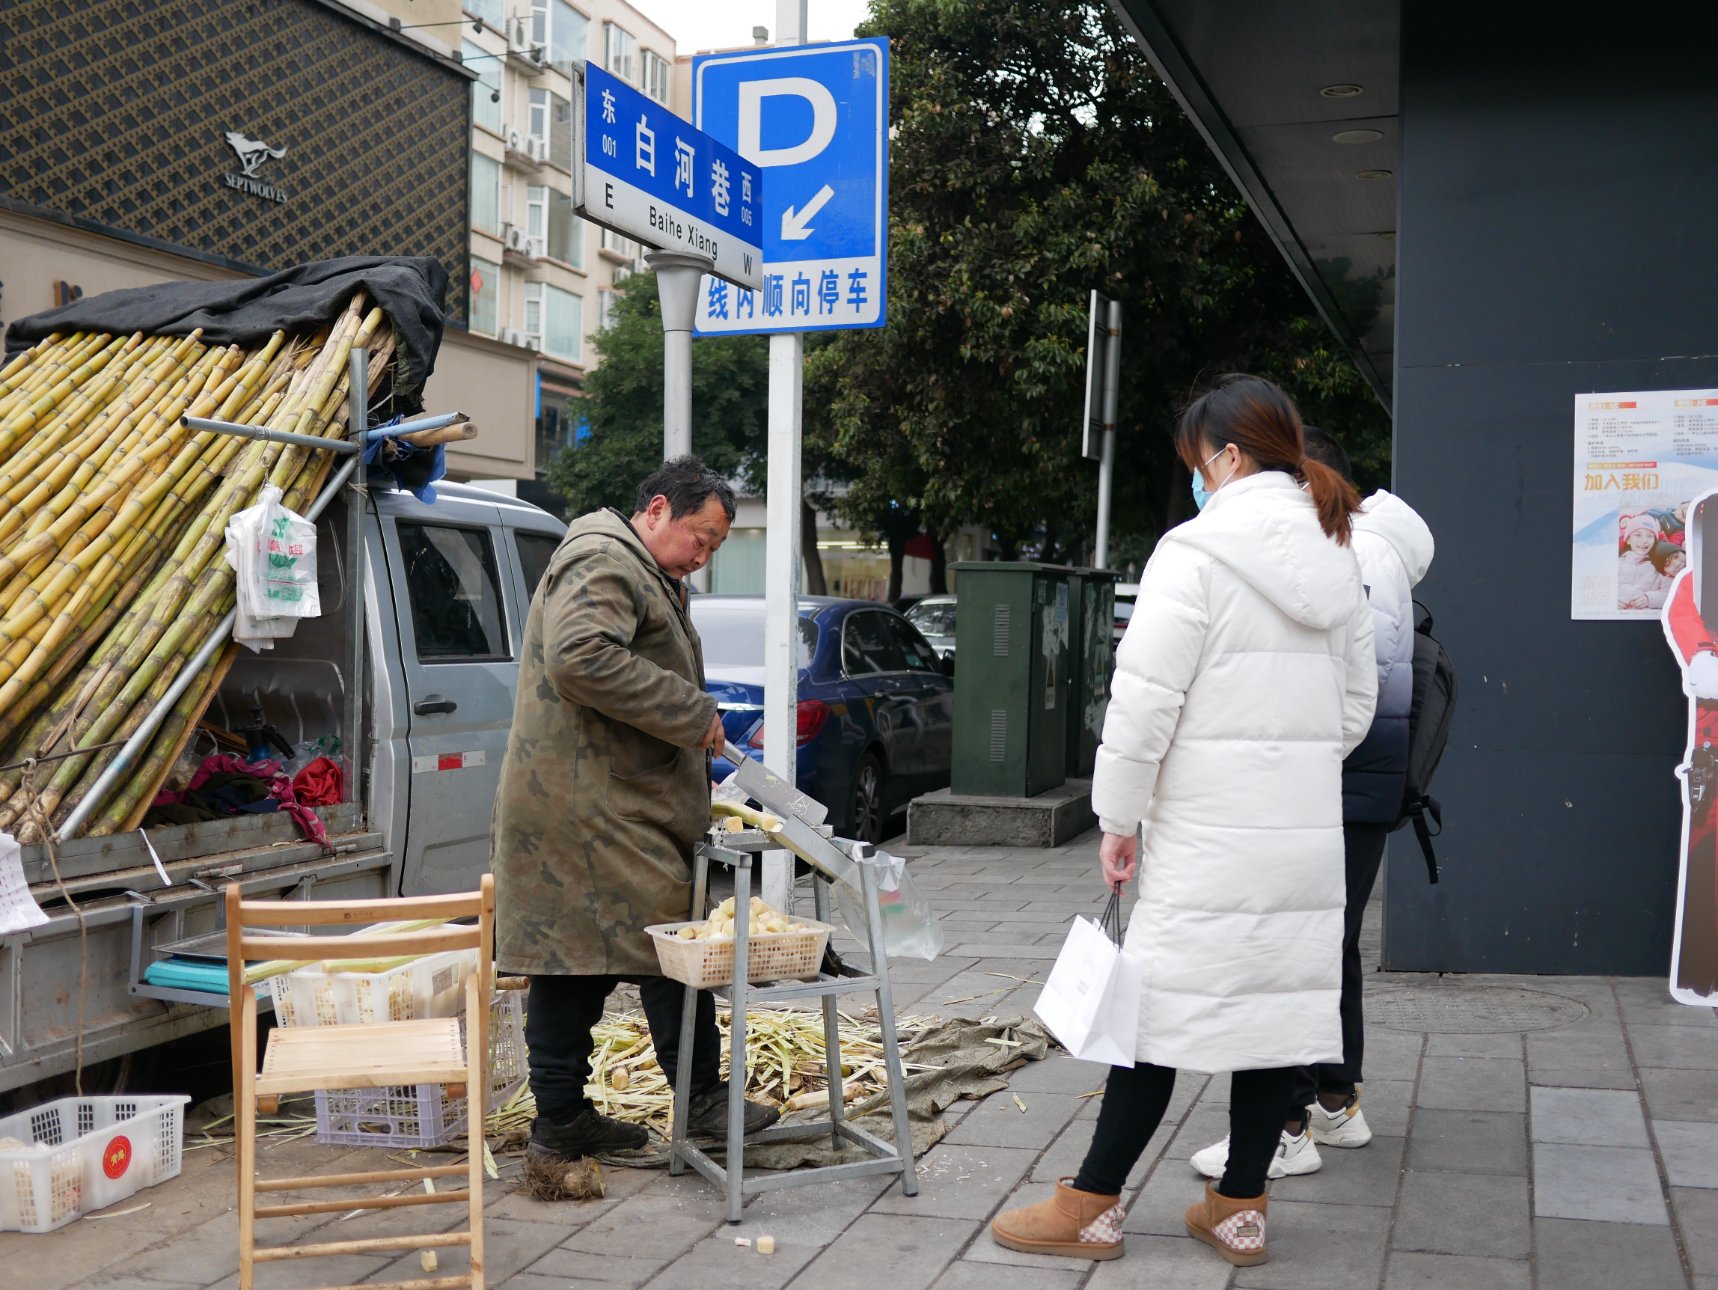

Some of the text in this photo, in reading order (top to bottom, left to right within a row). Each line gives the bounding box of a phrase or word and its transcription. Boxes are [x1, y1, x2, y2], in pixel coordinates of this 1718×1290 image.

[602, 88, 616, 124] 东
[602, 134, 616, 159] 001
[636, 113, 731, 218] 白河巷
[225, 173, 287, 203] SEPTWOLVES
[605, 182, 614, 209] E
[741, 171, 752, 204] 西
[649, 205, 718, 261] Baihe Xiang
[743, 252, 752, 277] W
[707, 267, 869, 320] 线内顺向停车
[1584, 473, 1660, 491] 加入我们
